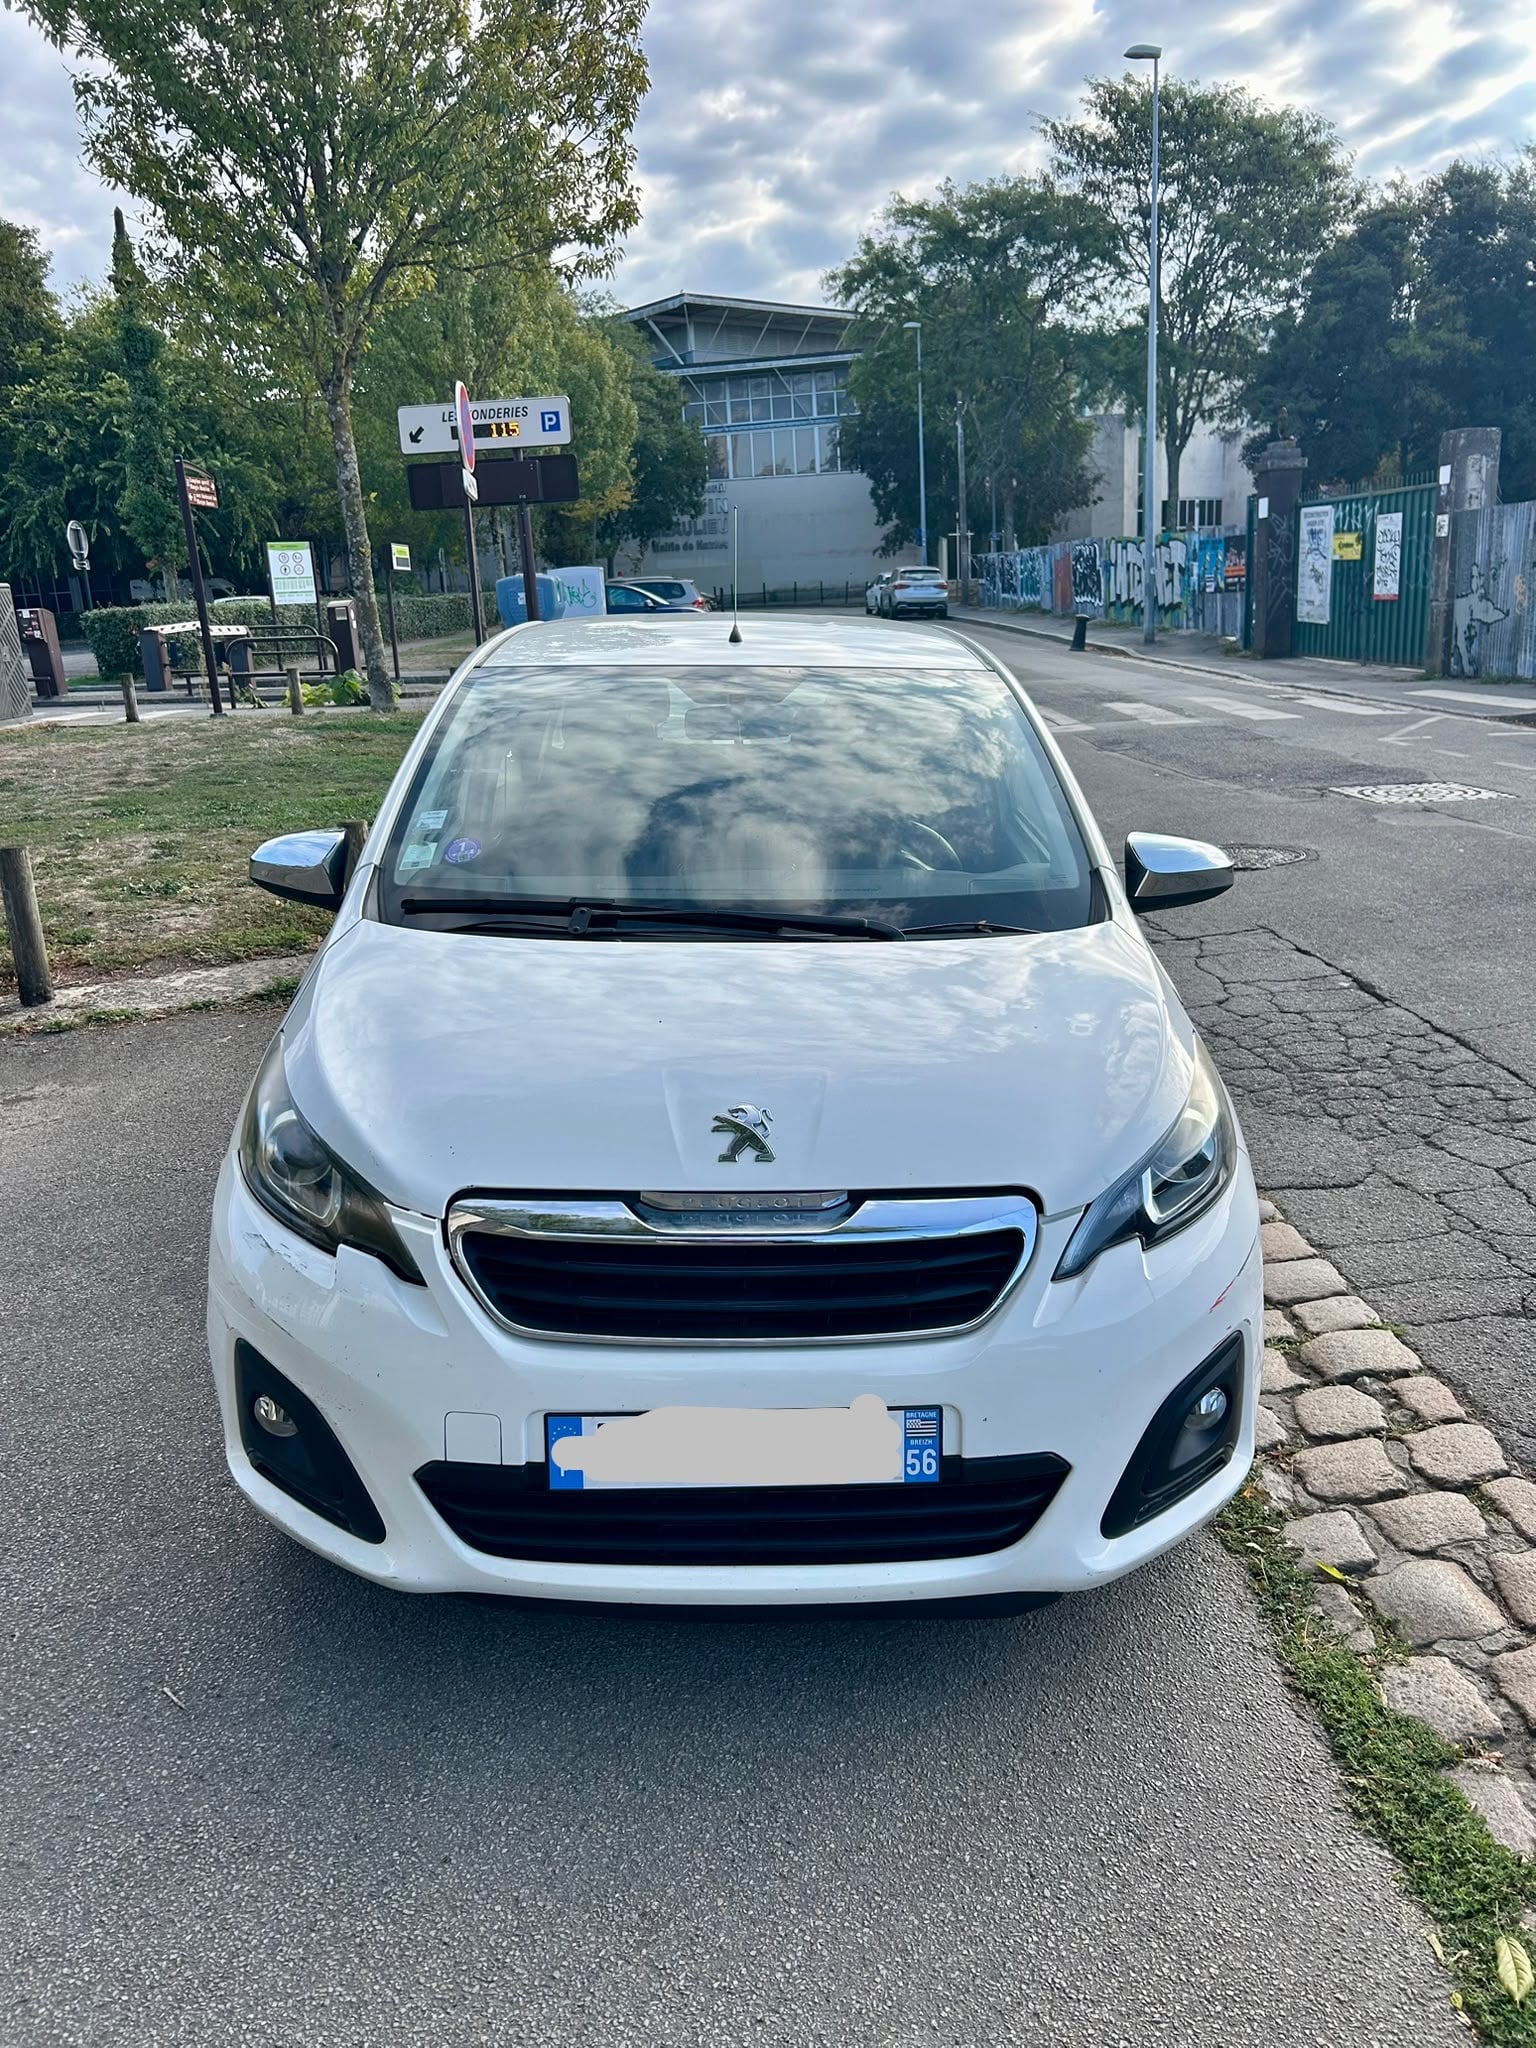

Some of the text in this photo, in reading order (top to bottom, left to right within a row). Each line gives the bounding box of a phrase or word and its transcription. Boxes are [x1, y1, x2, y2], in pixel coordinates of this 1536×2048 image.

[469, 406, 529, 420] ONDERIES
[491, 421, 520, 438] 115
[545, 414, 557, 430] P
[906, 1411, 937, 1419] BRETAGNE
[906, 1448, 937, 1476] 56
